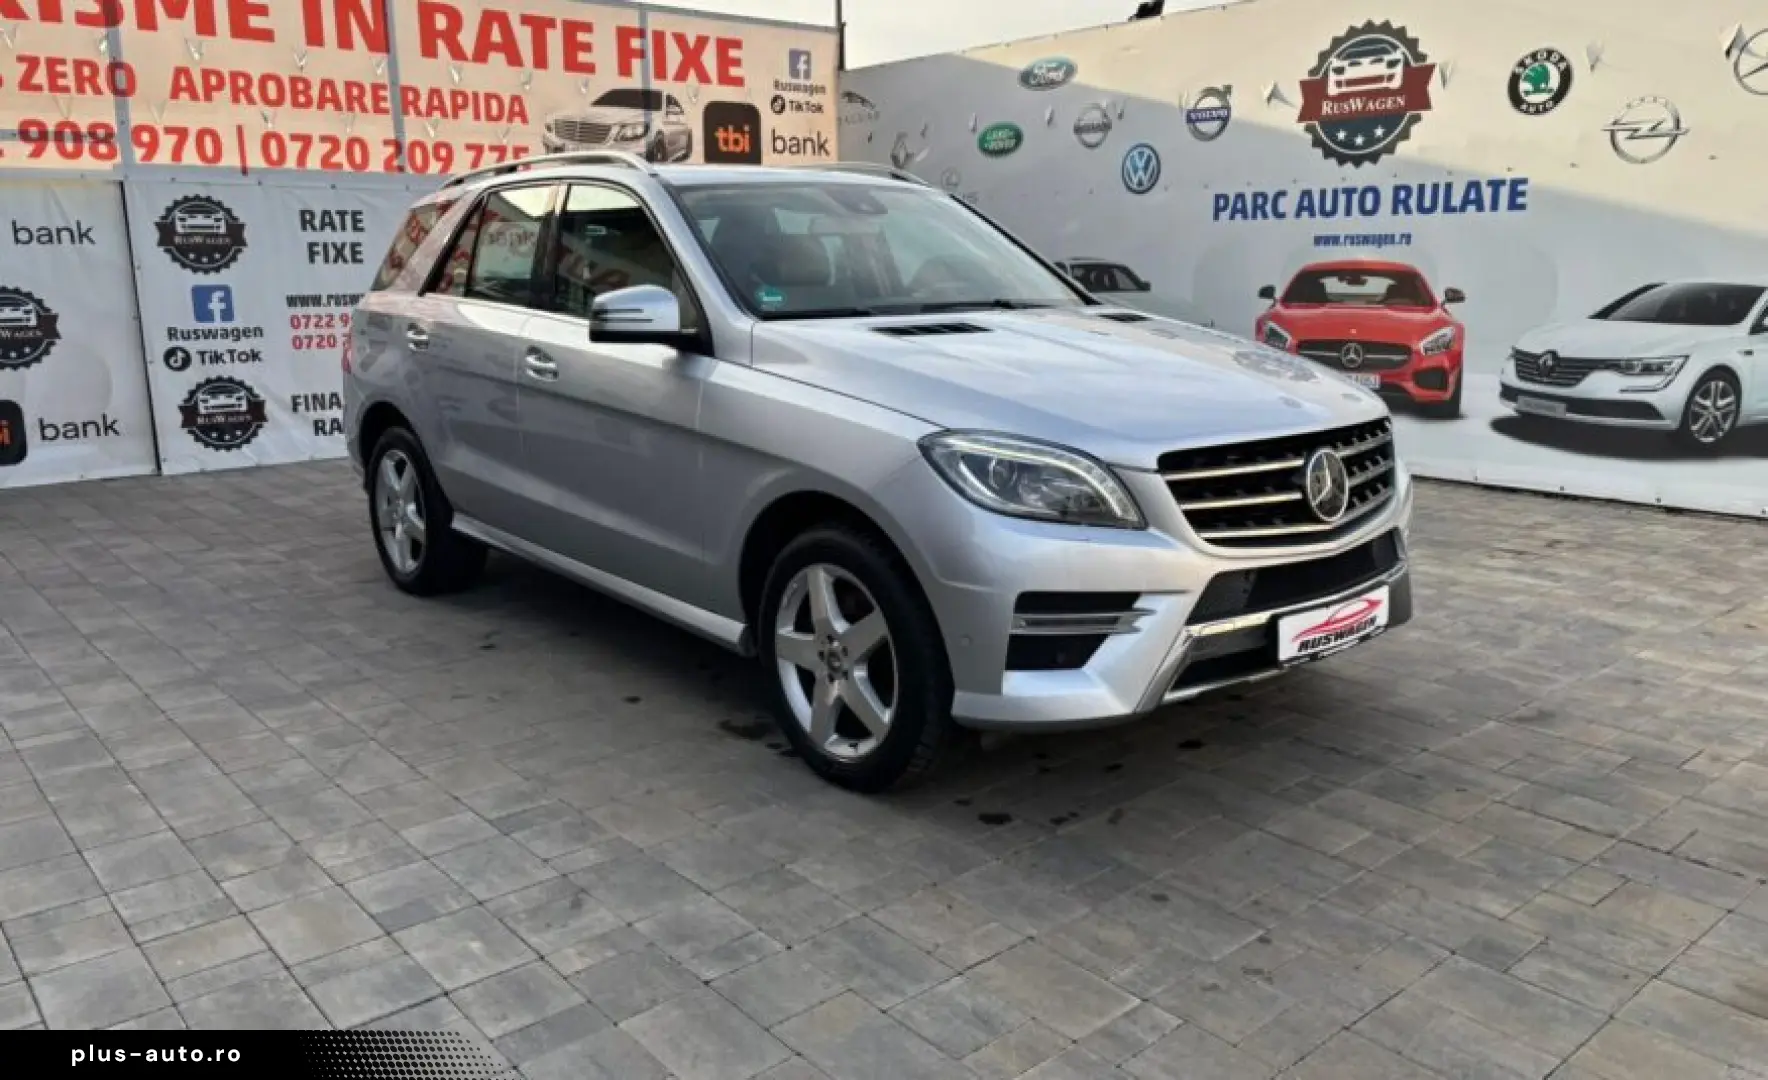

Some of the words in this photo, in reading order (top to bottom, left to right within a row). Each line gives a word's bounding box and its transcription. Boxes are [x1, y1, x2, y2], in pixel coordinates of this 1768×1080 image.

[302, 0, 391, 54] IN
[416, 1, 597, 75] RATE
[615, 26, 746, 88] FIXE
[15, 54, 138, 98] ZERO
[168, 66, 391, 116] APROBARE
[399, 84, 530, 126] RAPIDA
[17, 119, 119, 162] 908
[130, 123, 224, 165] 970
[260, 131, 371, 172] 0720
[382, 139, 455, 175] 209
[714, 125, 750, 154] tbi
[770, 126, 831, 157] bank
[1213, 190, 1287, 222] PARC
[1294, 184, 1383, 219] AUTO
[1392, 177, 1530, 216] RULATE
[11, 219, 96, 246] bank
[299, 209, 366, 233] RATE
[307, 241, 365, 265] FIXE
[1313, 233, 1413, 249] www.ruswagen.ro
[167, 324, 264, 342] Ruswagen
[289, 313, 336, 330] 0722
[291, 334, 338, 350] 0720
[197, 348, 263, 365] TikTok
[290, 391, 343, 413] FINA
[38, 413, 121, 441] bank
[313, 417, 344, 437] RA
